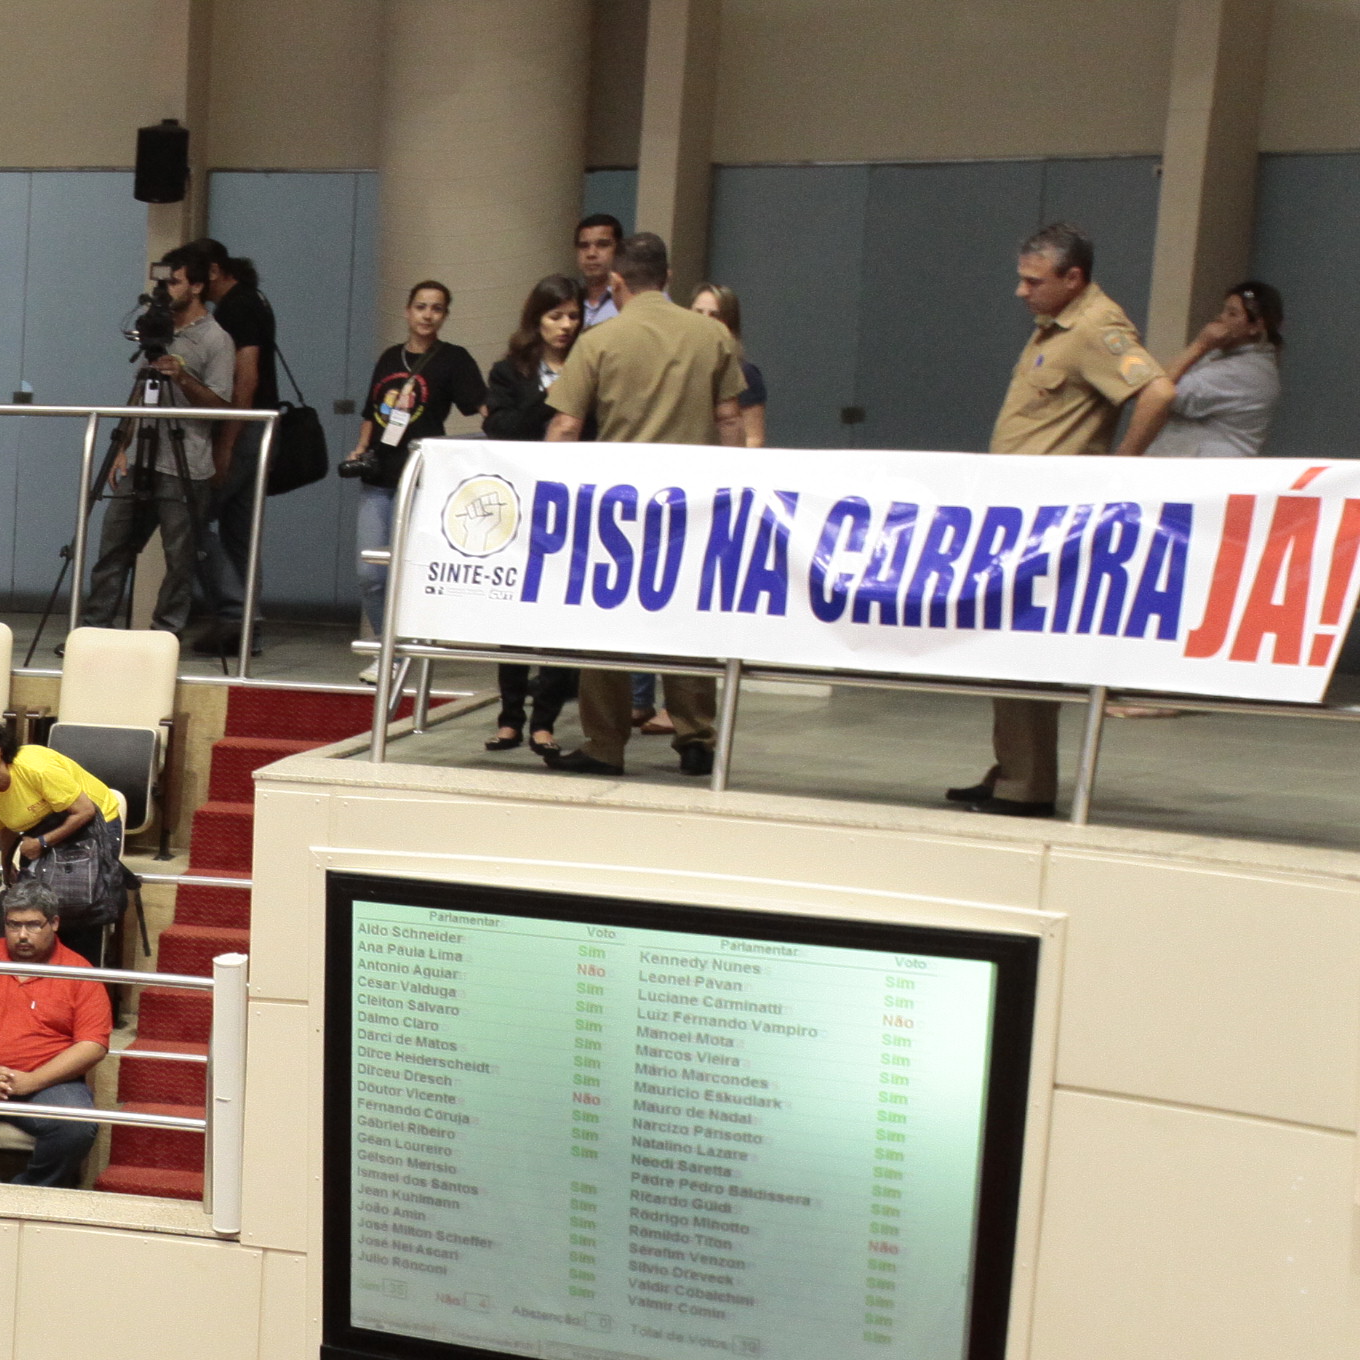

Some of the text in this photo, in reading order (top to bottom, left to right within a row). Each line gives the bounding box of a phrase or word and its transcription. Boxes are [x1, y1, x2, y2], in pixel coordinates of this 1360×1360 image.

[427, 561, 518, 587] SINTE-SC
[520, 466, 1360, 667] PISO NA CARREIRA JÁ!
[429, 910, 500, 927] Parlamentar
[357, 923, 463, 944] Aldo Schneider
[586, 927, 616, 939] Voto
[357, 941, 463, 962] Ana Paula Lima
[578, 944, 606, 959] Sim
[720, 939, 798, 957] Parlamentar
[357, 958, 409, 974] Antonio
[577, 963, 606, 977] Não
[639, 951, 762, 974] Kennedy Nunes
[895, 956, 927, 969] Voto
[357, 976, 457, 999] Cesar Valduga
[576, 982, 604, 996] Sim
[639, 970, 743, 992] Leonel Pavan
[884, 975, 915, 990] Sim
[408, 999, 459, 1016] Salvaro
[638, 989, 783, 1015] Luciane Carminatti
[883, 994, 914, 1009] Sim
[357, 1011, 439, 1031] Dalmo Claro
[637, 1007, 818, 1039] Luiz Fernando Vampiro
[357, 1029, 458, 1052] Darci de Matos
[636, 1026, 734, 1048] Manoel Mota
[635, 1045, 740, 1068] Marcos Vieira
[357, 1063, 452, 1086] Dirceu Dresch
[682, 1069, 769, 1090] Marcondes
